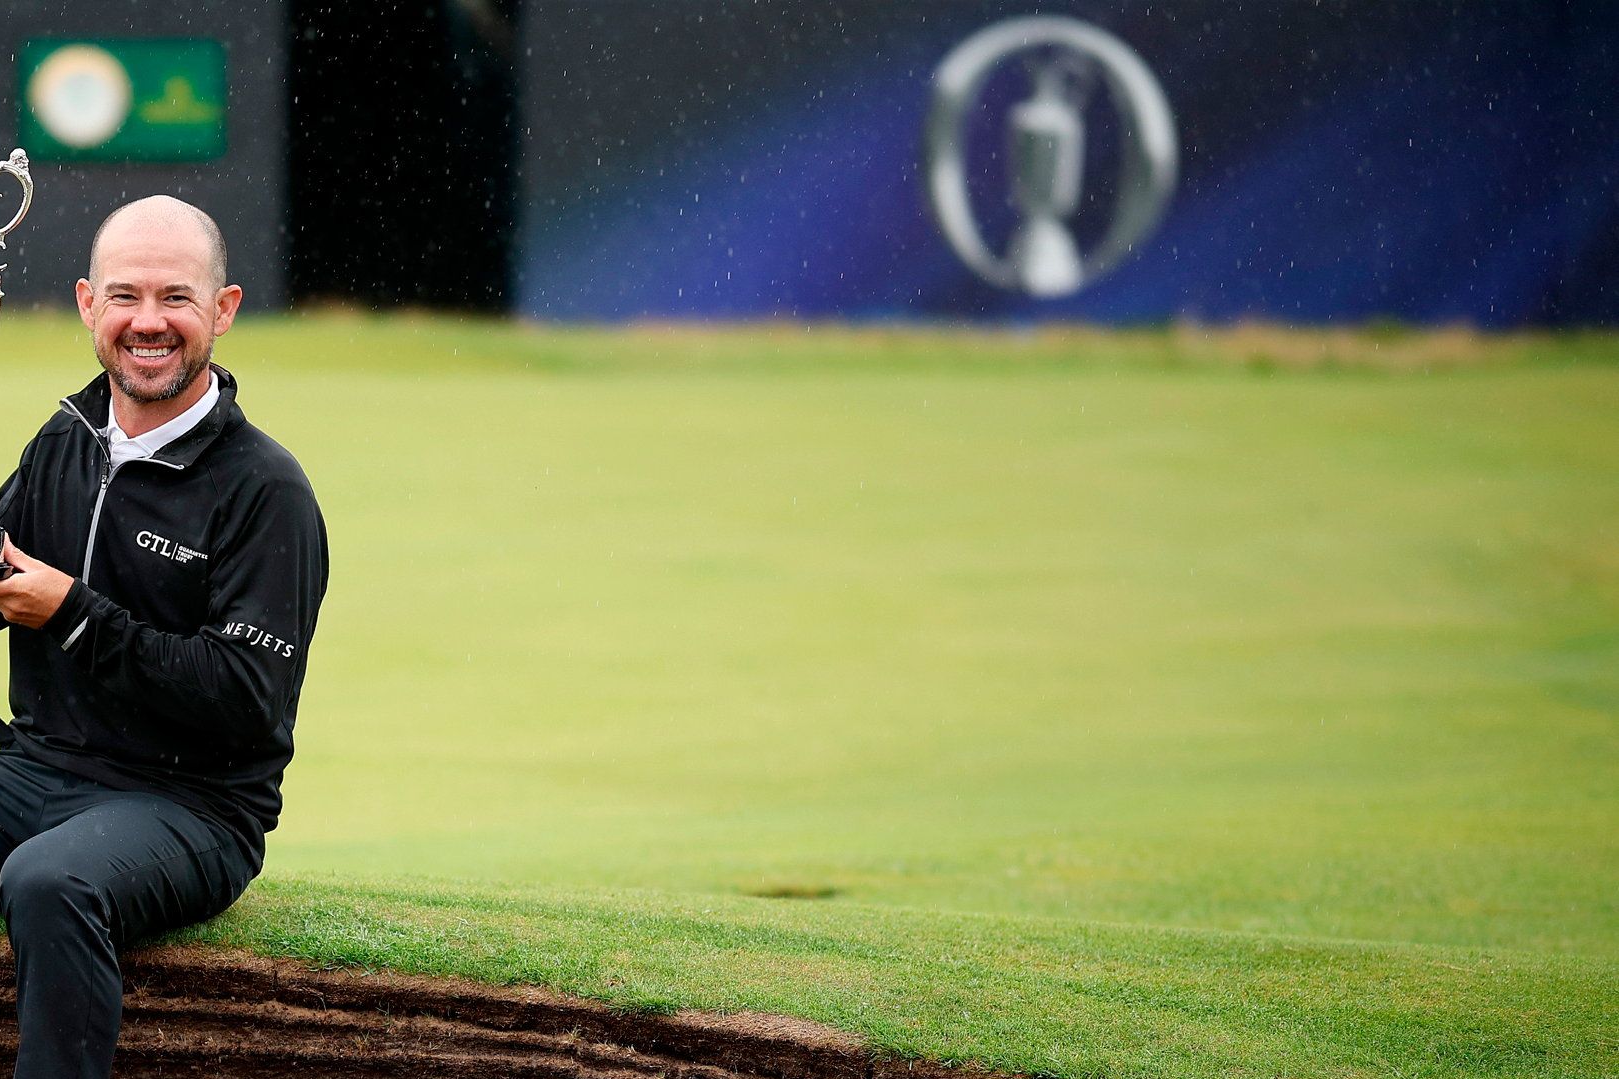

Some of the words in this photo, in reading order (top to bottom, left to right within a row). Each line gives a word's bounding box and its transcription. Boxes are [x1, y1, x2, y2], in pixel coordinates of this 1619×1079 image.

[136, 530, 172, 558] GTL
[175, 555, 187, 563] LIFE
[177, 550, 193, 561] TRUST
[178, 545, 208, 560] GUARANTEE
[221, 622, 295, 658] NETJETS
